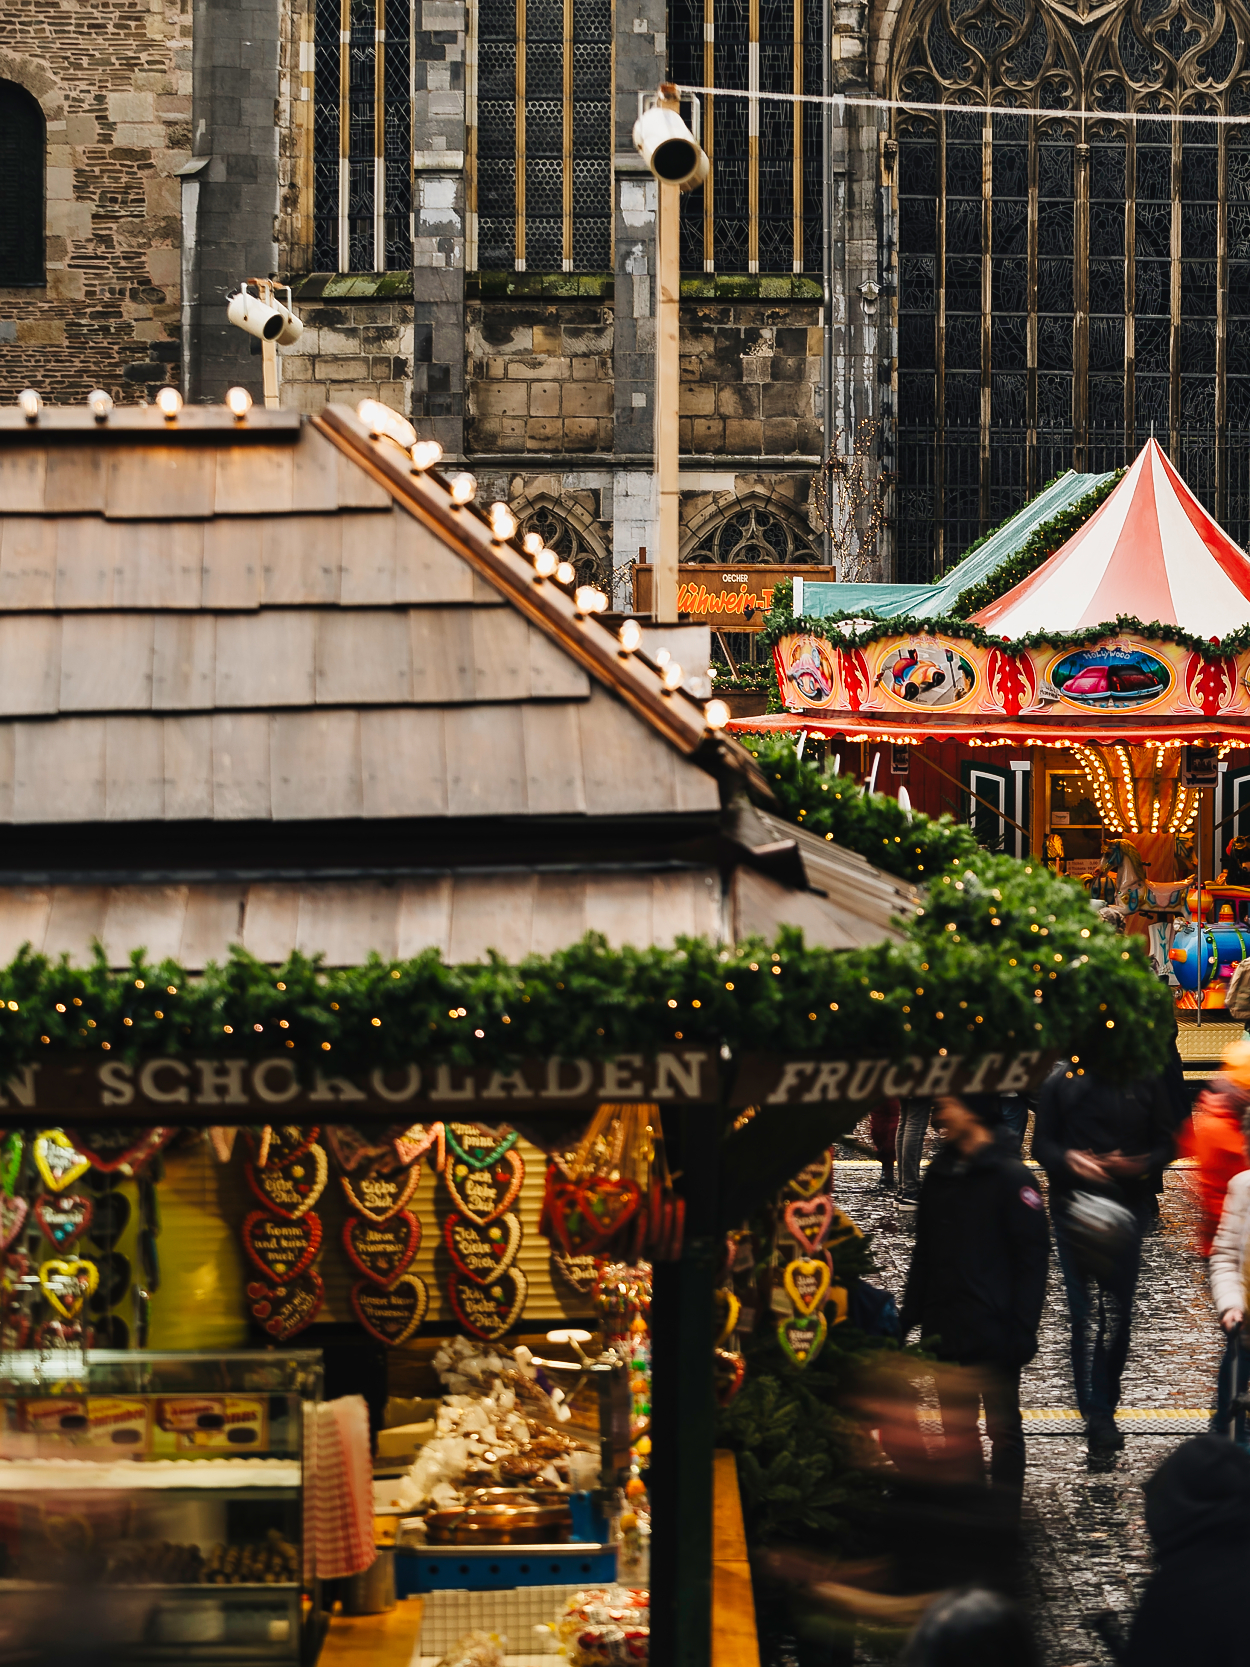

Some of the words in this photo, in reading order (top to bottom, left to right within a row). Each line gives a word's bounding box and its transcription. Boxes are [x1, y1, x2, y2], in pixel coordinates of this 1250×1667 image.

[722, 574, 748, 583] OECHER
[676, 582, 774, 615] lühwein-T
[1083, 649, 1131, 660] HOLLYWOOD
[98, 1053, 707, 1104] SCHOKOLADEN
